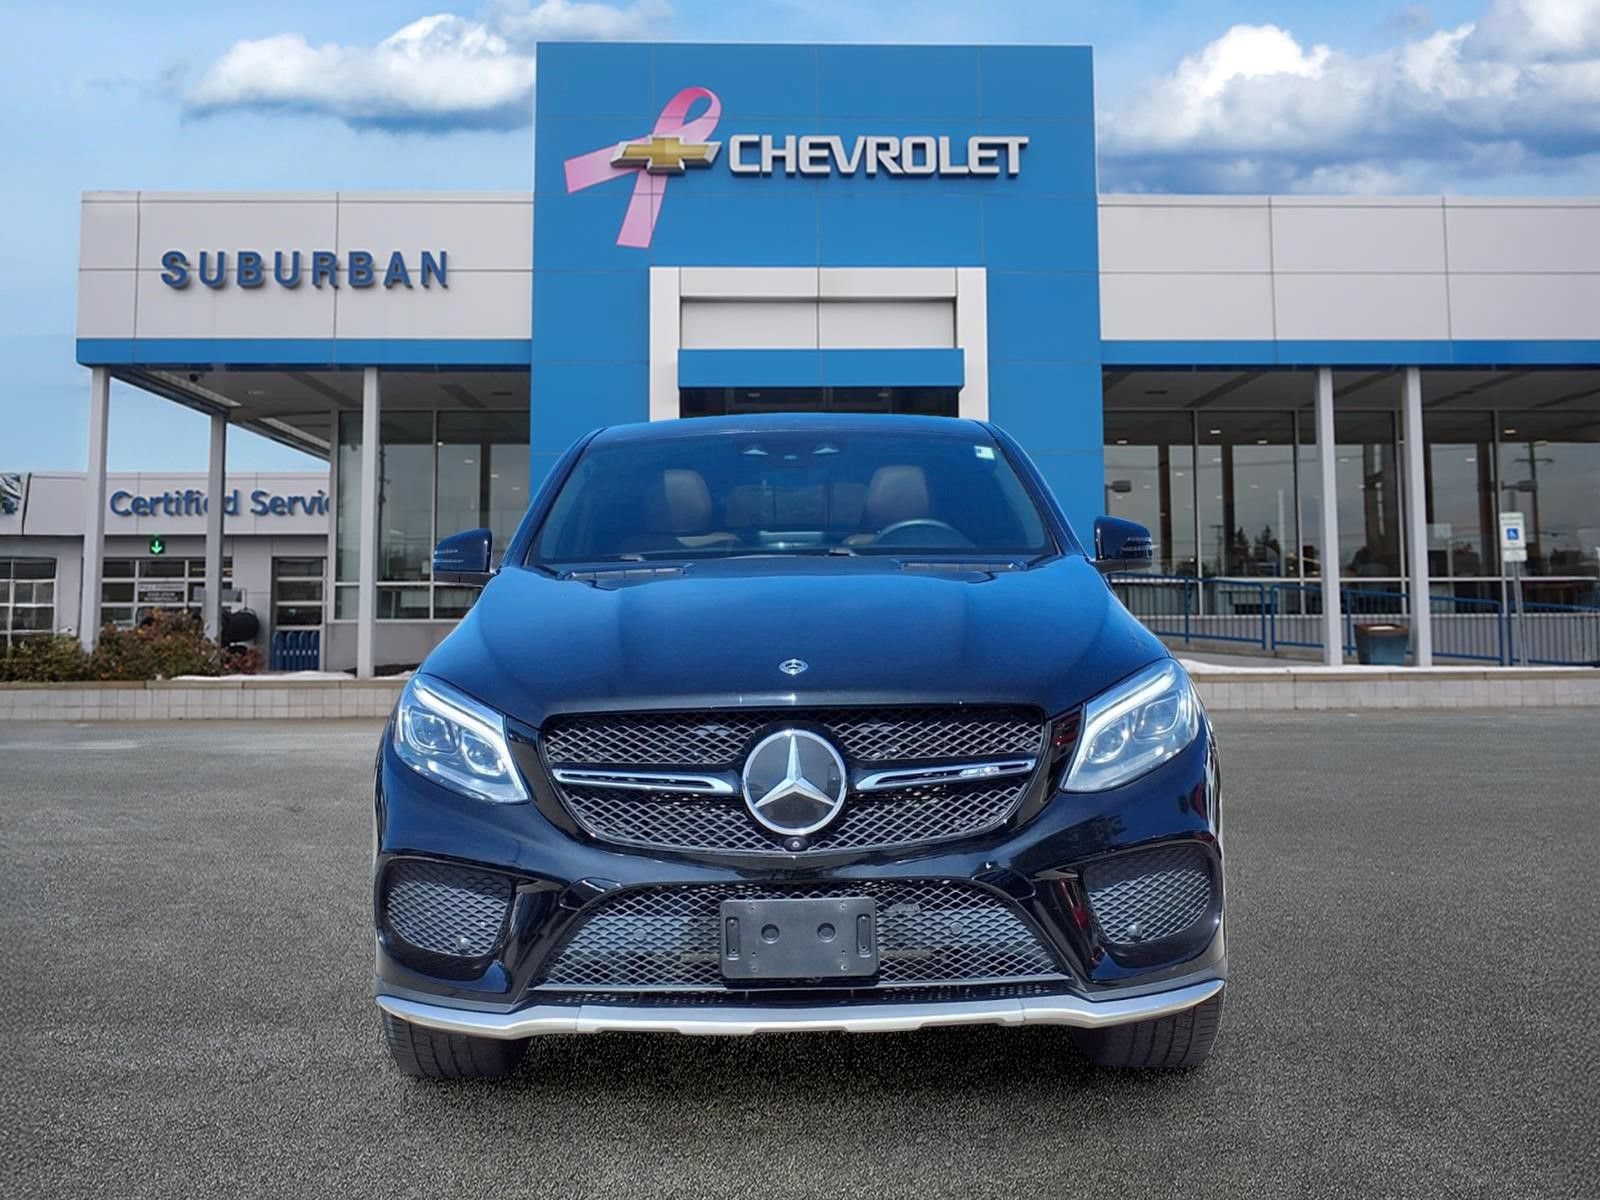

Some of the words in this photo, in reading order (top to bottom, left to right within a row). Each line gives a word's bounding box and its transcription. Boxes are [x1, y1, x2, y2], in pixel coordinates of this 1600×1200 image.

[729, 134, 1029, 176] CHEVROLET
[161, 250, 449, 290] SUBURBAN
[110, 489, 239, 516] Certifid
[250, 489, 329, 516] Servi
